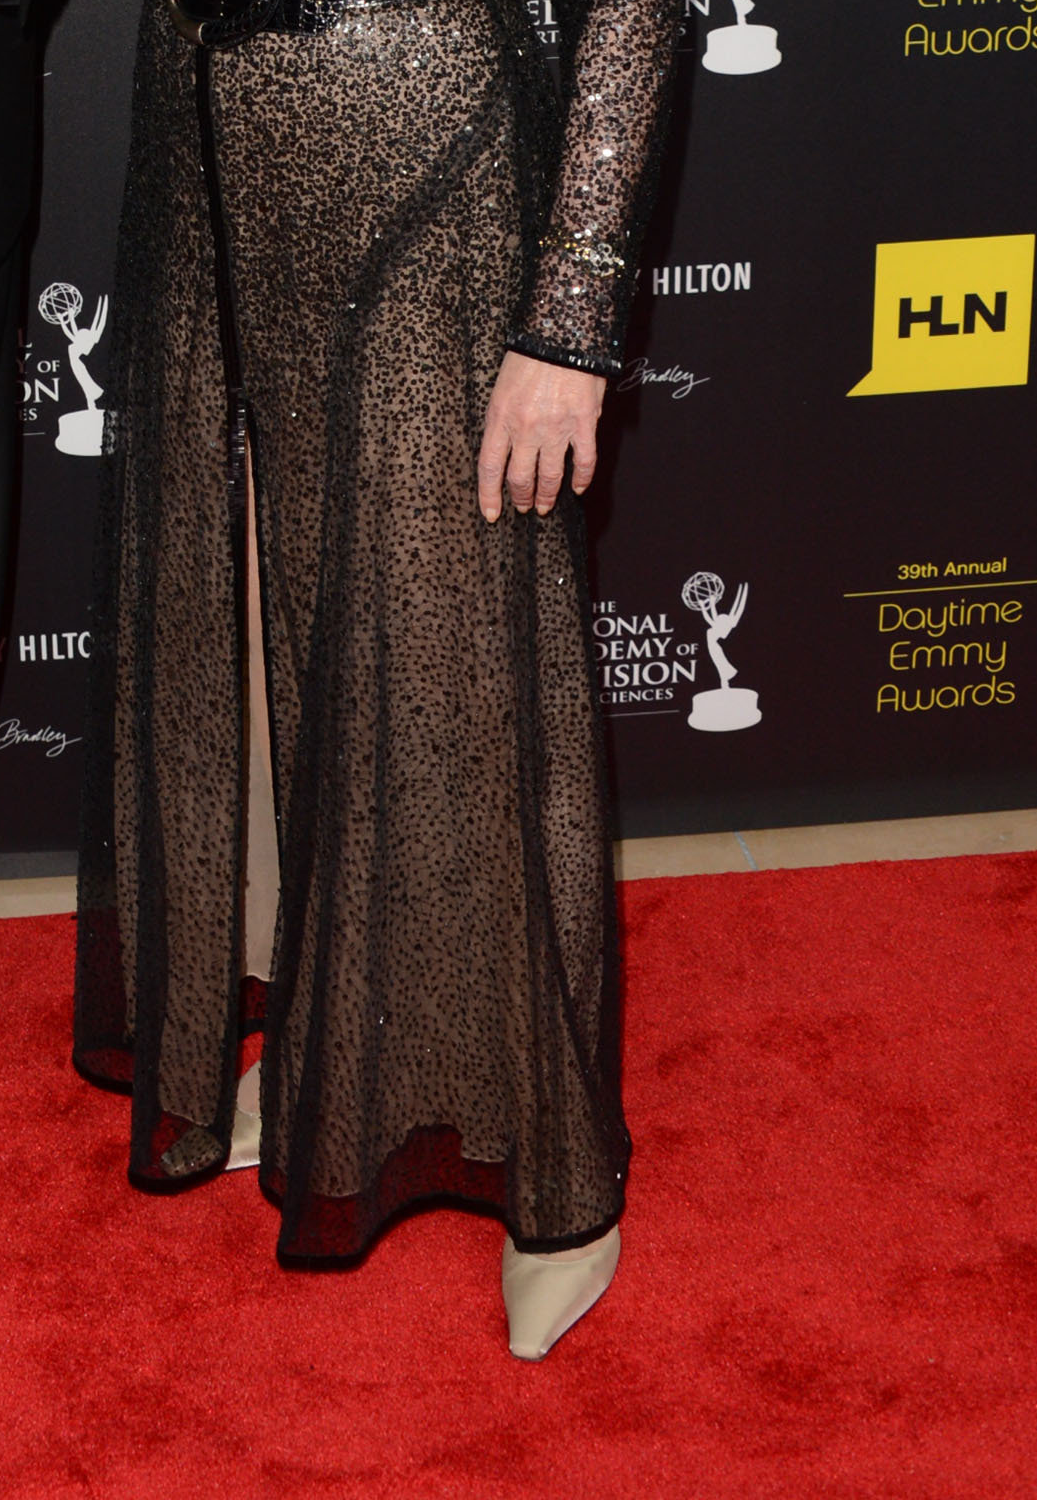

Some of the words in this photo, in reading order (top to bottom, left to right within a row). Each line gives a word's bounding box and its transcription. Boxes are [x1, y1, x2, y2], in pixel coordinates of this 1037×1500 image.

[905, 16, 1037, 56] Award
[653, 262, 751, 295] HILTON
[898, 291, 1008, 339] HLN
[37, 360, 60, 373] OF
[897, 562, 939, 580] 39th
[944, 557, 1007, 577] Annual
[593, 601, 616, 613] HE
[878, 598, 1023, 638] Daytime
[593, 614, 674, 637] ONAL
[19, 631, 91, 662] HILTO
[595, 637, 672, 660] DEMY
[676, 643, 699, 656] OF
[889, 640, 1007, 673] Emmy
[603, 659, 697, 688] ISION
[599, 687, 674, 703] CIENCES
[876, 675, 1016, 713] Awards
